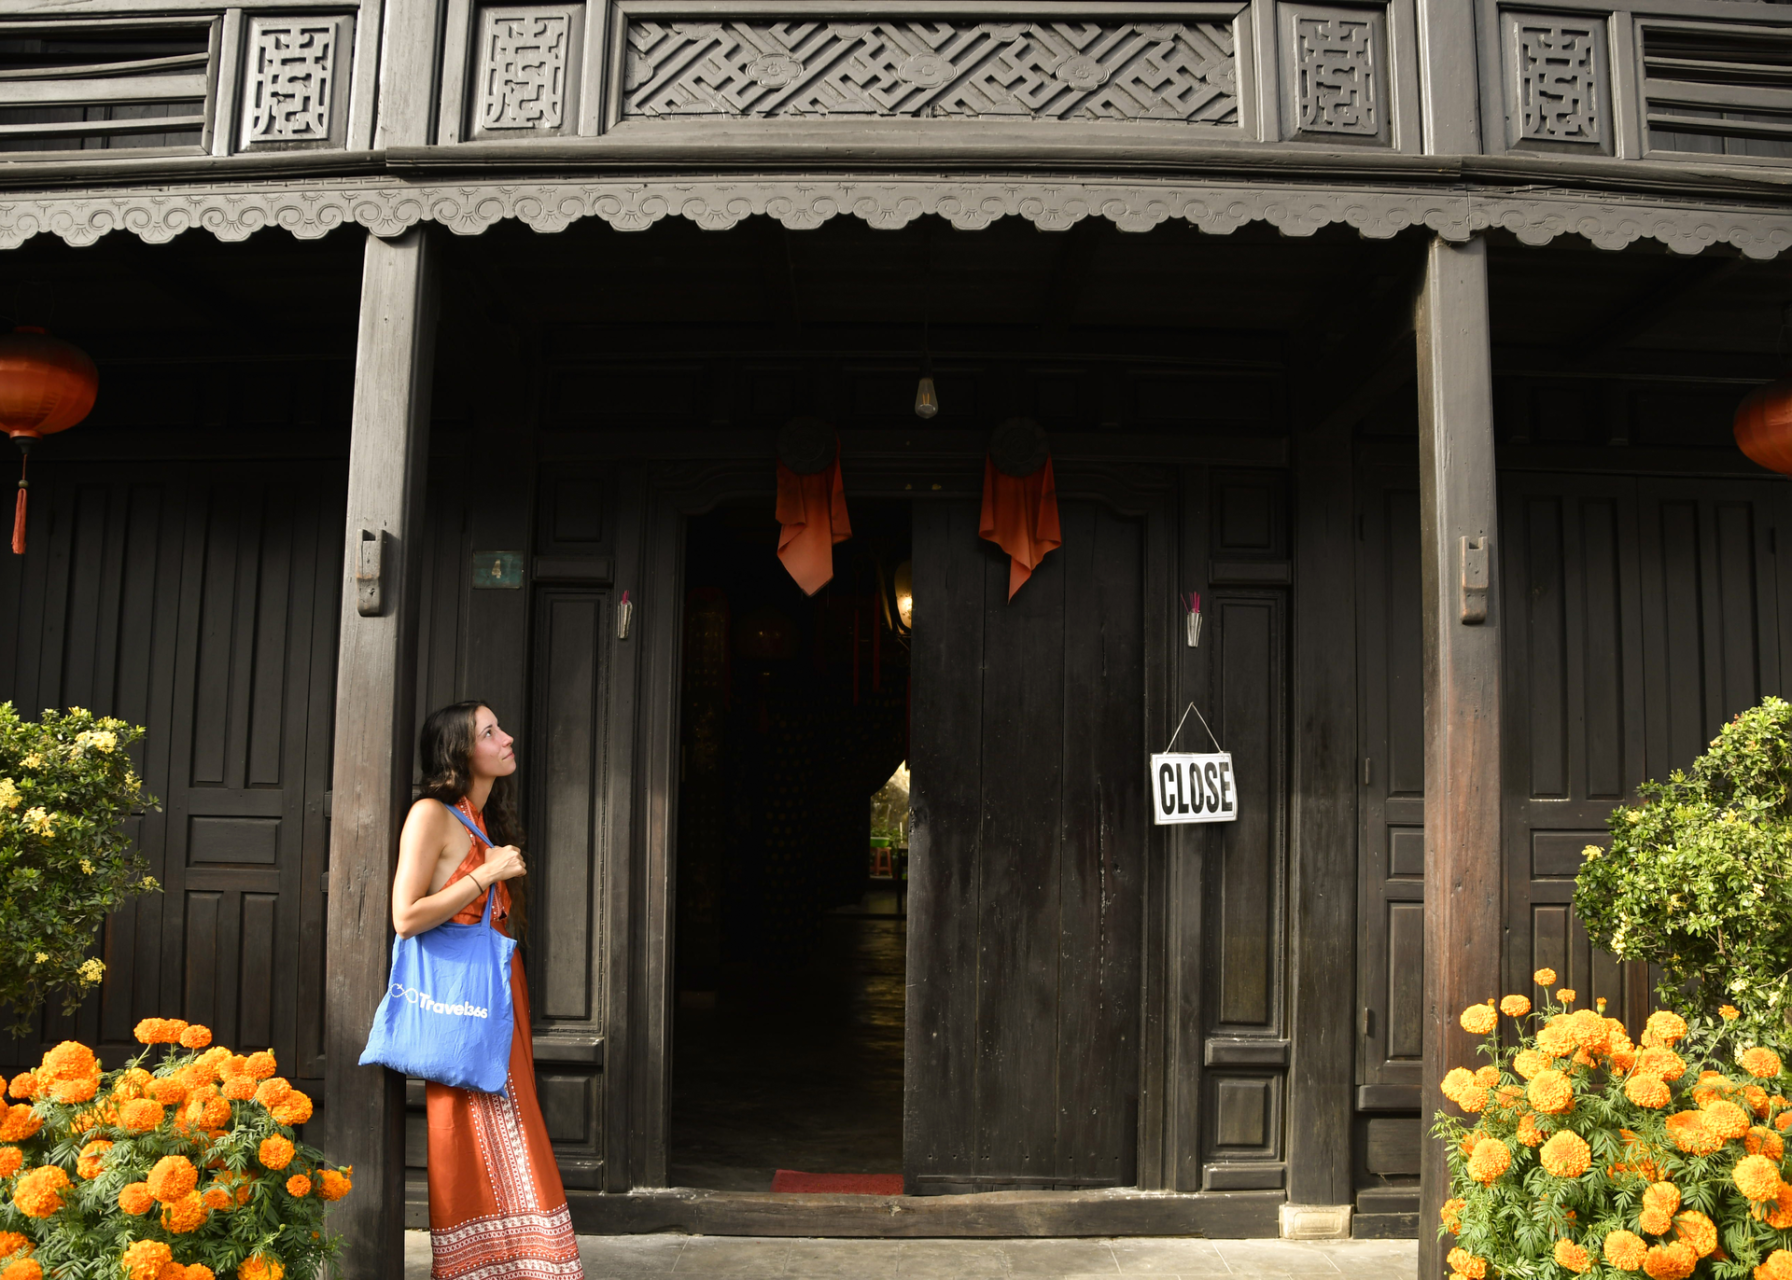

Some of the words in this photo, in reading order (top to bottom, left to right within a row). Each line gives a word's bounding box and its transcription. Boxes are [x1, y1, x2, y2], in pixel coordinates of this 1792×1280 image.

[491, 559, 502, 579] 4
[1159, 762, 1233, 815] CLOSE
[420, 992, 488, 1019] Travel365
